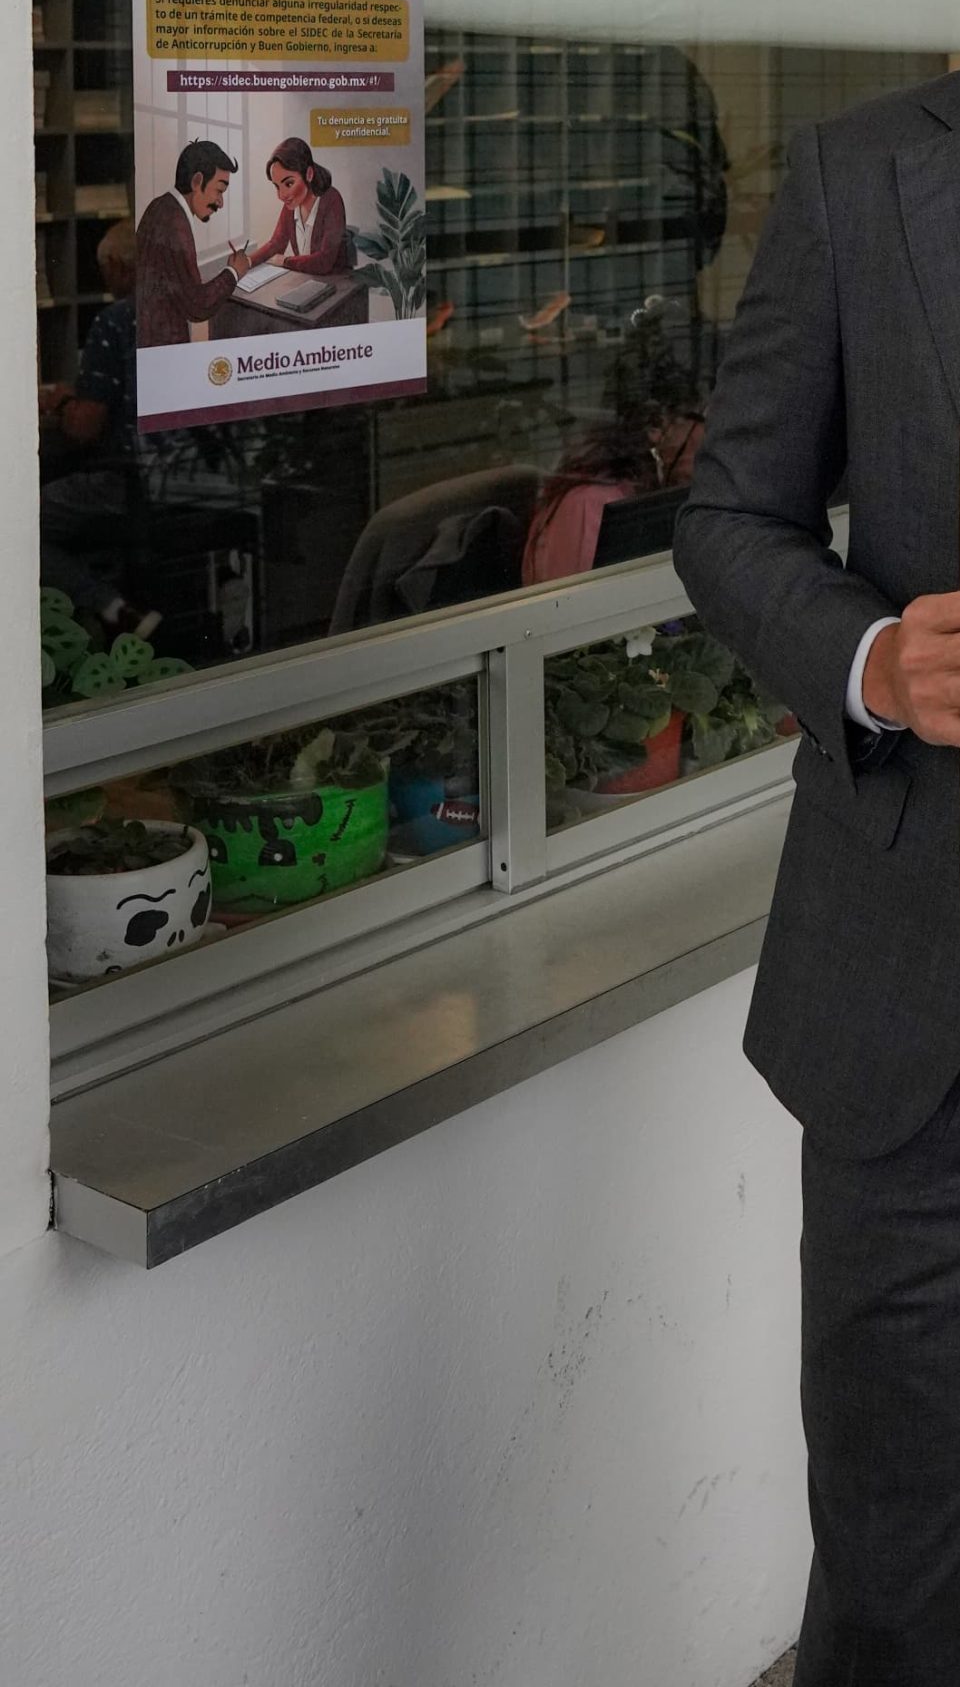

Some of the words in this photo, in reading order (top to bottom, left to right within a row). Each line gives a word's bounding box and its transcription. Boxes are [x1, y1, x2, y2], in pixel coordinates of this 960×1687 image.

[308, 0, 367, 12] irregularidad
[371, 2, 401, 13] respec-
[155, 10, 166, 19] to
[169, 9, 181, 19] de
[184, 11, 197, 20] un
[200, 10, 237, 21] trámite
[240, 11, 252, 21] de
[255, 13, 316, 24] competencia
[318, 14, 352, 25] federal,
[355, 17, 361, 25] o
[363, 16, 369, 25] si
[371, 16, 402, 25] deseas
[155, 25, 189, 36] mayor
[193, 24, 254, 36] información
[258, 26, 285, 36] sobre
[288, 28, 297, 36] el
[301, 27, 328, 37] SIDEC
[331, 28, 342, 38] de
[346, 29, 354, 38] la
[155, 39, 168, 49] de
[171, 39, 247, 52] Anticorrupción
[250, 42, 256, 52] y
[259, 42, 282, 51] Buen
[286, 41, 331, 53] Gobierno,
[334, 43, 367, 54] ingresa
[317, 116, 327, 125] Tu
[329, 116, 364, 126] denuncia
[366, 117, 375, 125] es
[377, 115, 408, 126] gratuita
[335, 130, 341, 138] y
[237, 352, 290, 374] Medio
[293, 344, 373, 367] Ambiente
